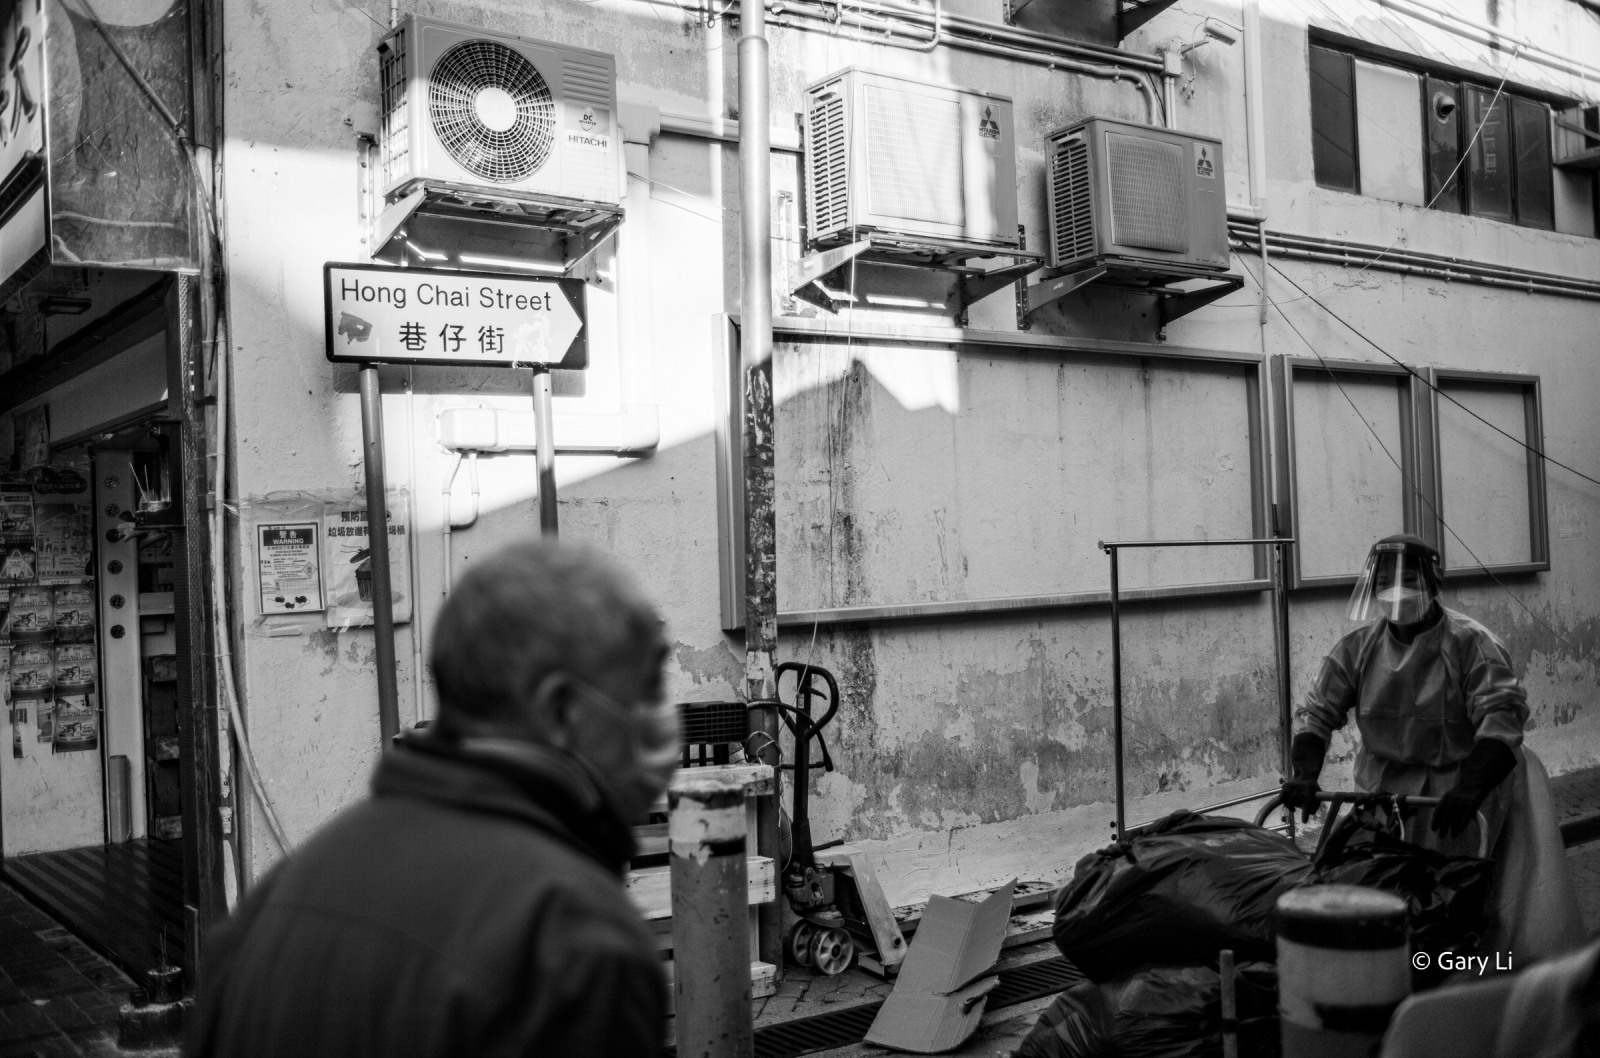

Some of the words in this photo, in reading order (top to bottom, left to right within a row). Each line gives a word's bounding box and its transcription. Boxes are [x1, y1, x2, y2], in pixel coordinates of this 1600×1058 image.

[583, 114, 593, 122] DC
[568, 134, 607, 148] HITACHI
[341, 278, 407, 309] Hong
[417, 283, 470, 307] Chai
[479, 286, 552, 311] Street
[399, 321, 505, 354] 巷仔街
